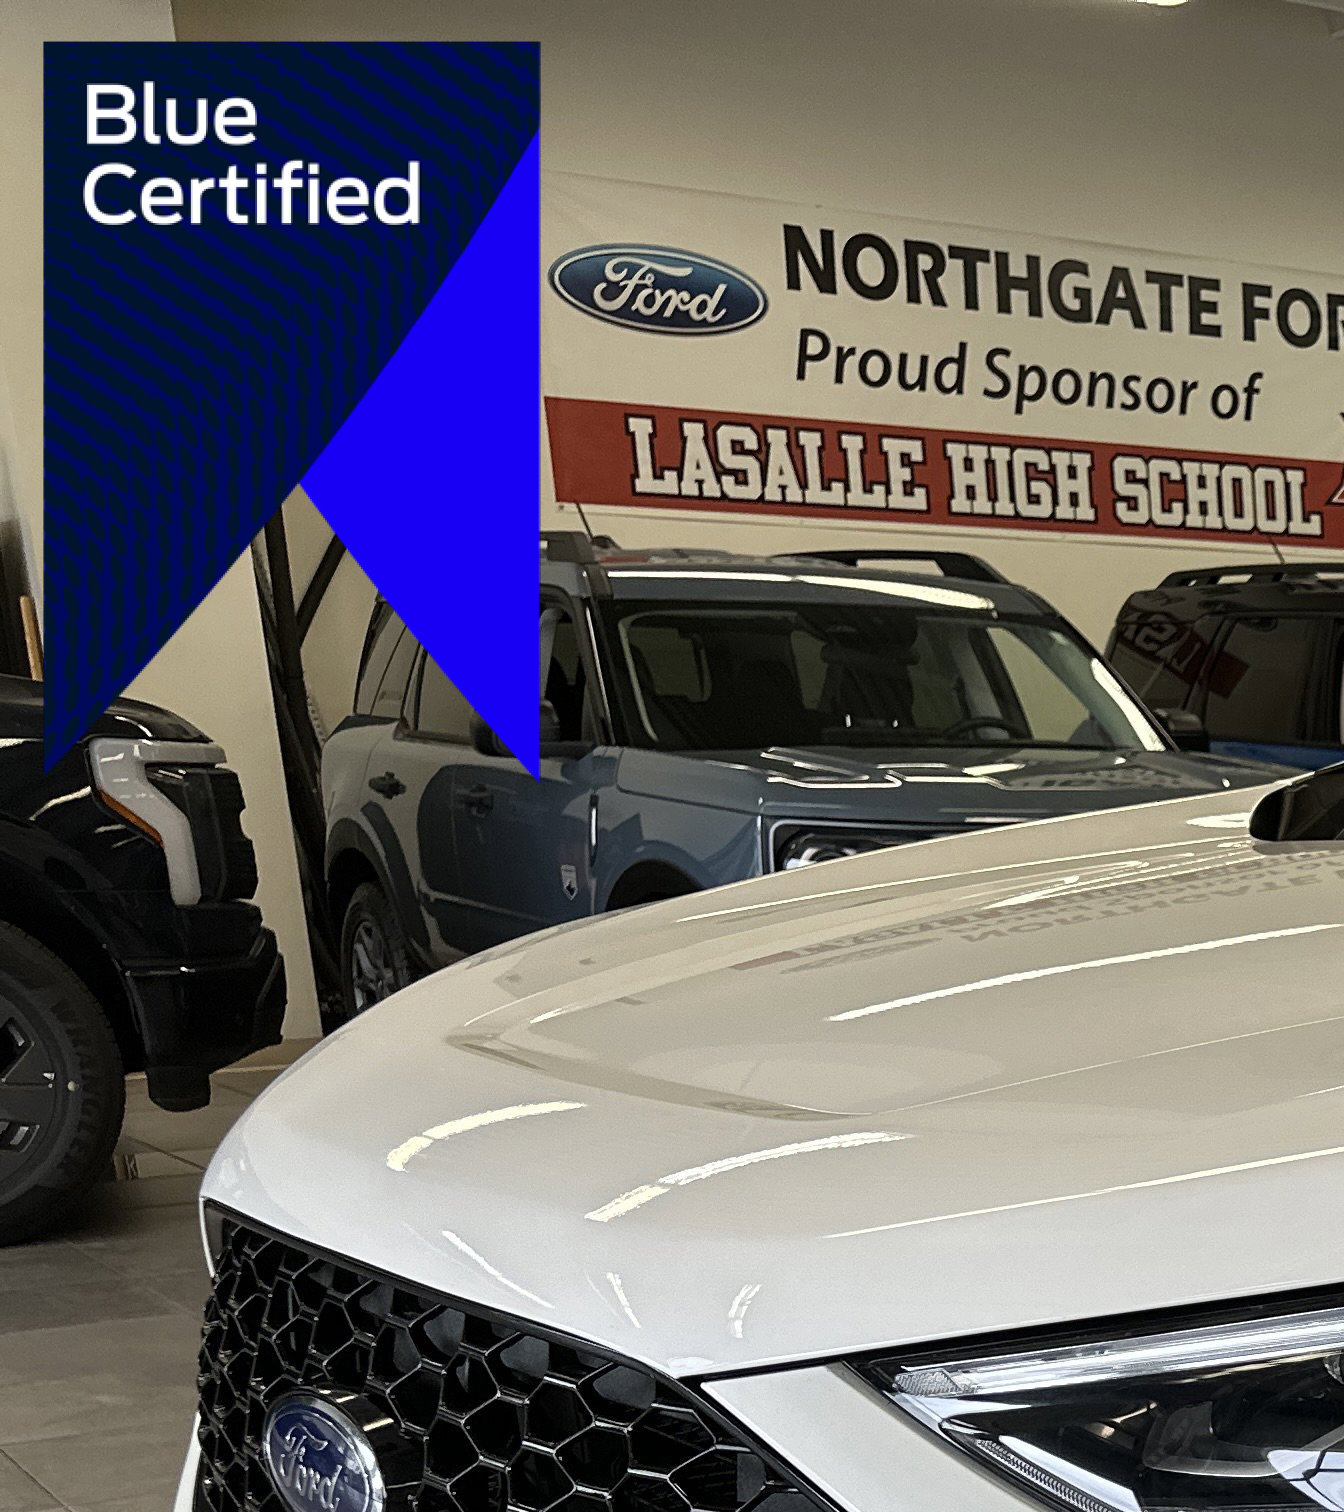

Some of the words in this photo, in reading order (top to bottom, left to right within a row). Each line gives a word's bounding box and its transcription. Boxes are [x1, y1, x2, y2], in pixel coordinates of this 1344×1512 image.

[593, 256, 728, 324] Ford
[783, 223, 1223, 339] NORTHGATE
[796, 328, 968, 396] Proud
[983, 347, 1199, 416] Sponsor
[1211, 371, 1265, 422] of
[624, 413, 931, 514] LASALLE
[943, 439, 1098, 524] HIGH
[1111, 454, 1325, 538] SCHOOL
[279, 1422, 342, 1512] Ford
